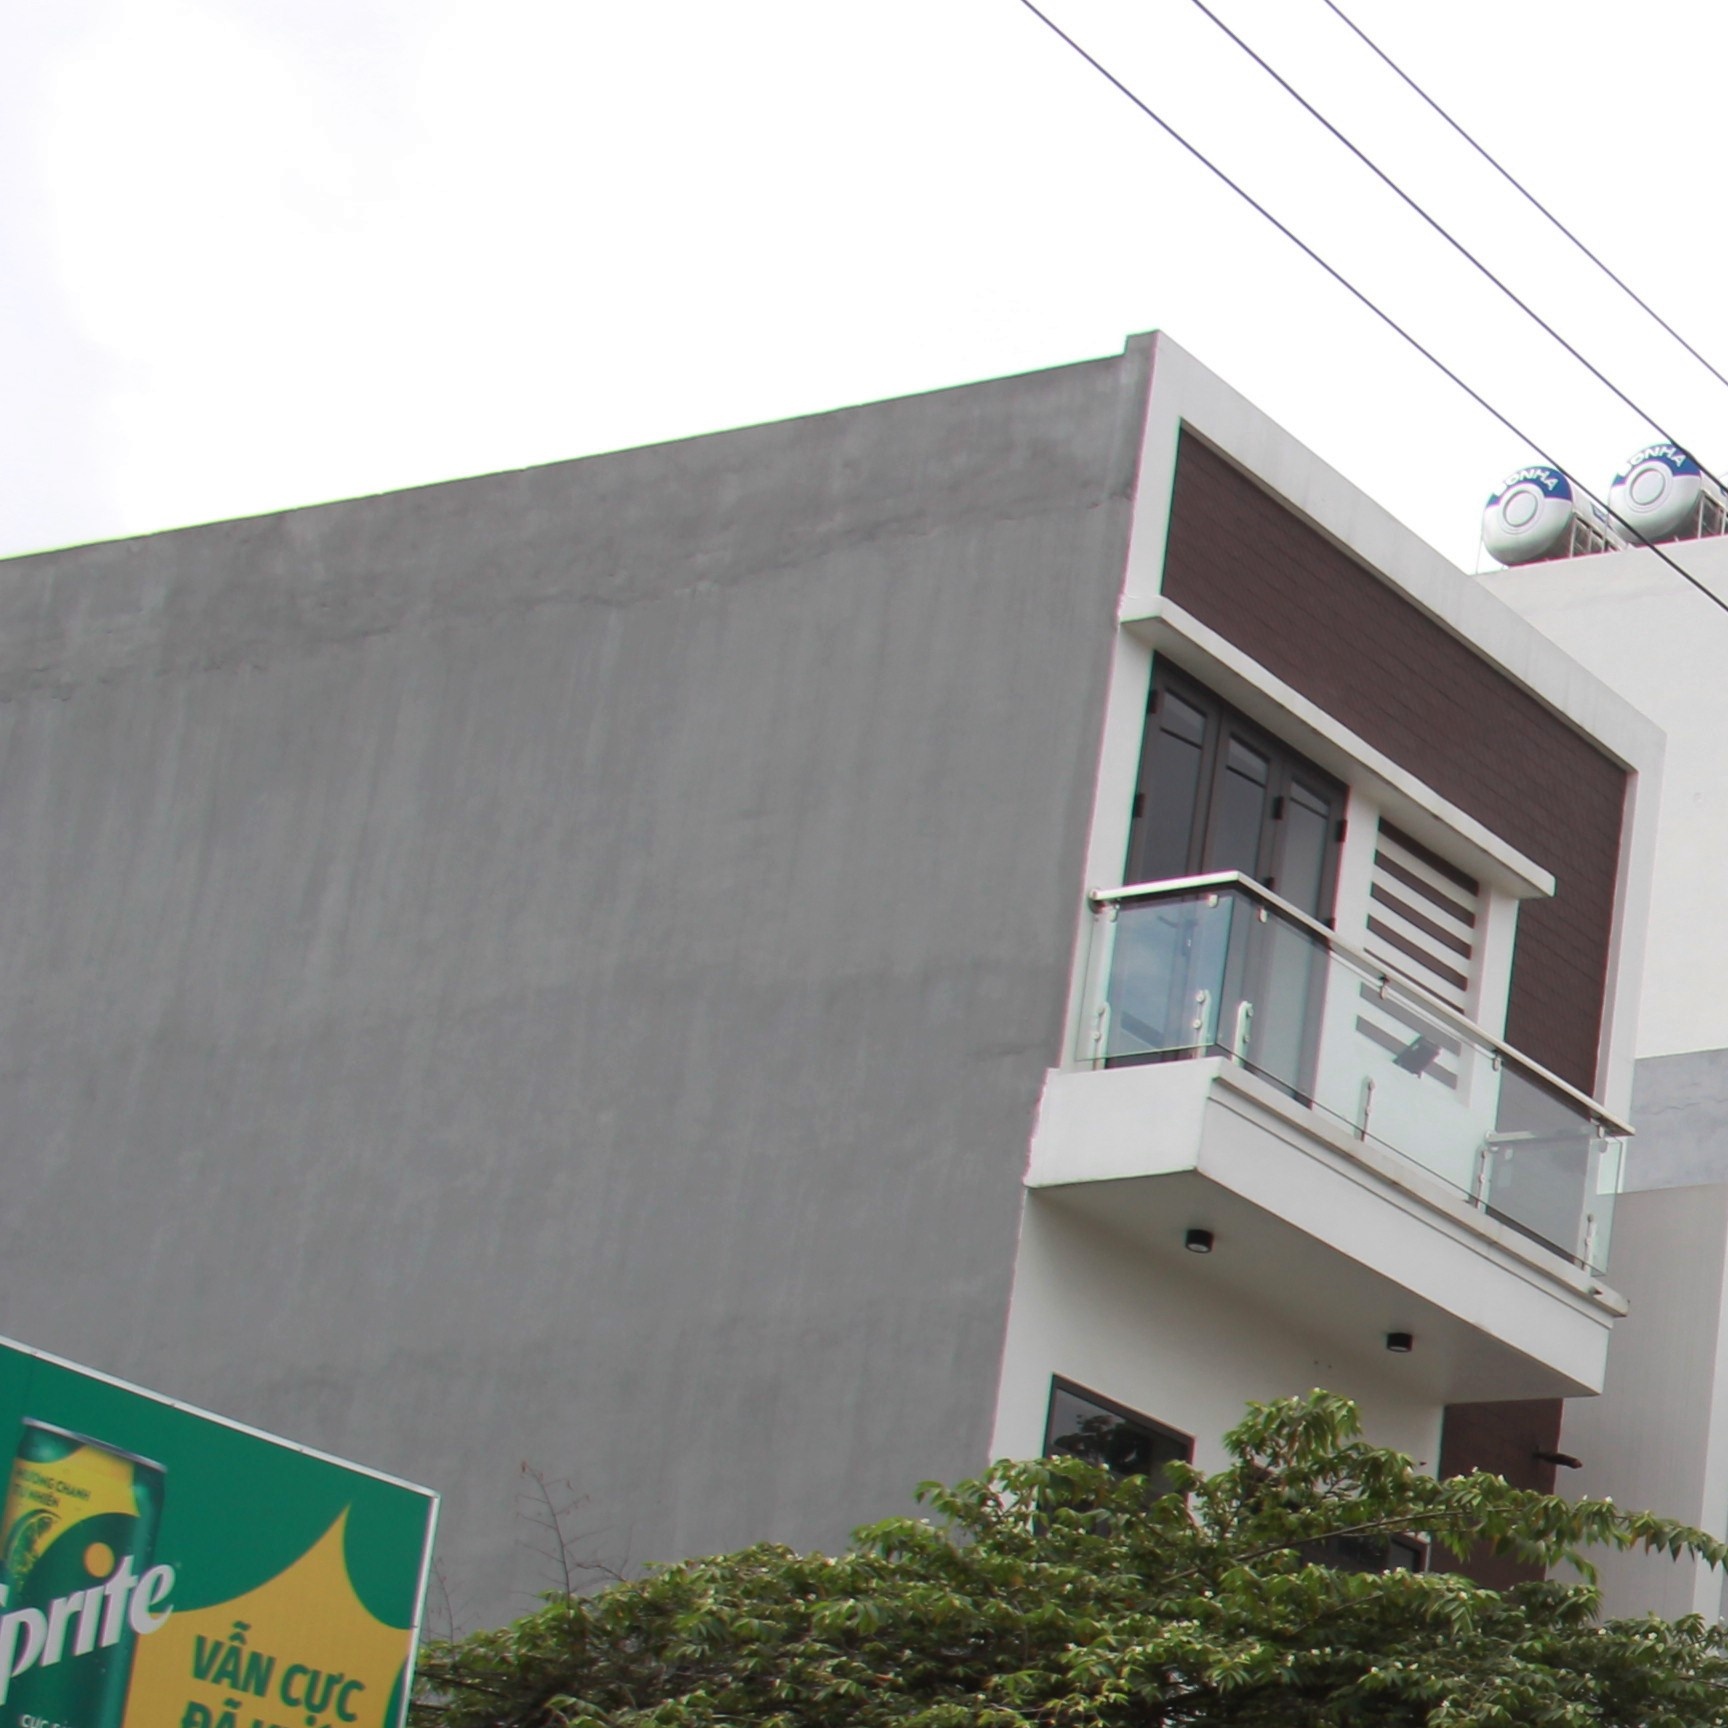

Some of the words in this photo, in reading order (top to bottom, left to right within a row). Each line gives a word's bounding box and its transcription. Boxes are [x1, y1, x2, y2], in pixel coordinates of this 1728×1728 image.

[0, 1555, 176, 1706] prite
[192, 1621, 277, 1698] VẪN
[279, 1664, 366, 1728] CỰC
